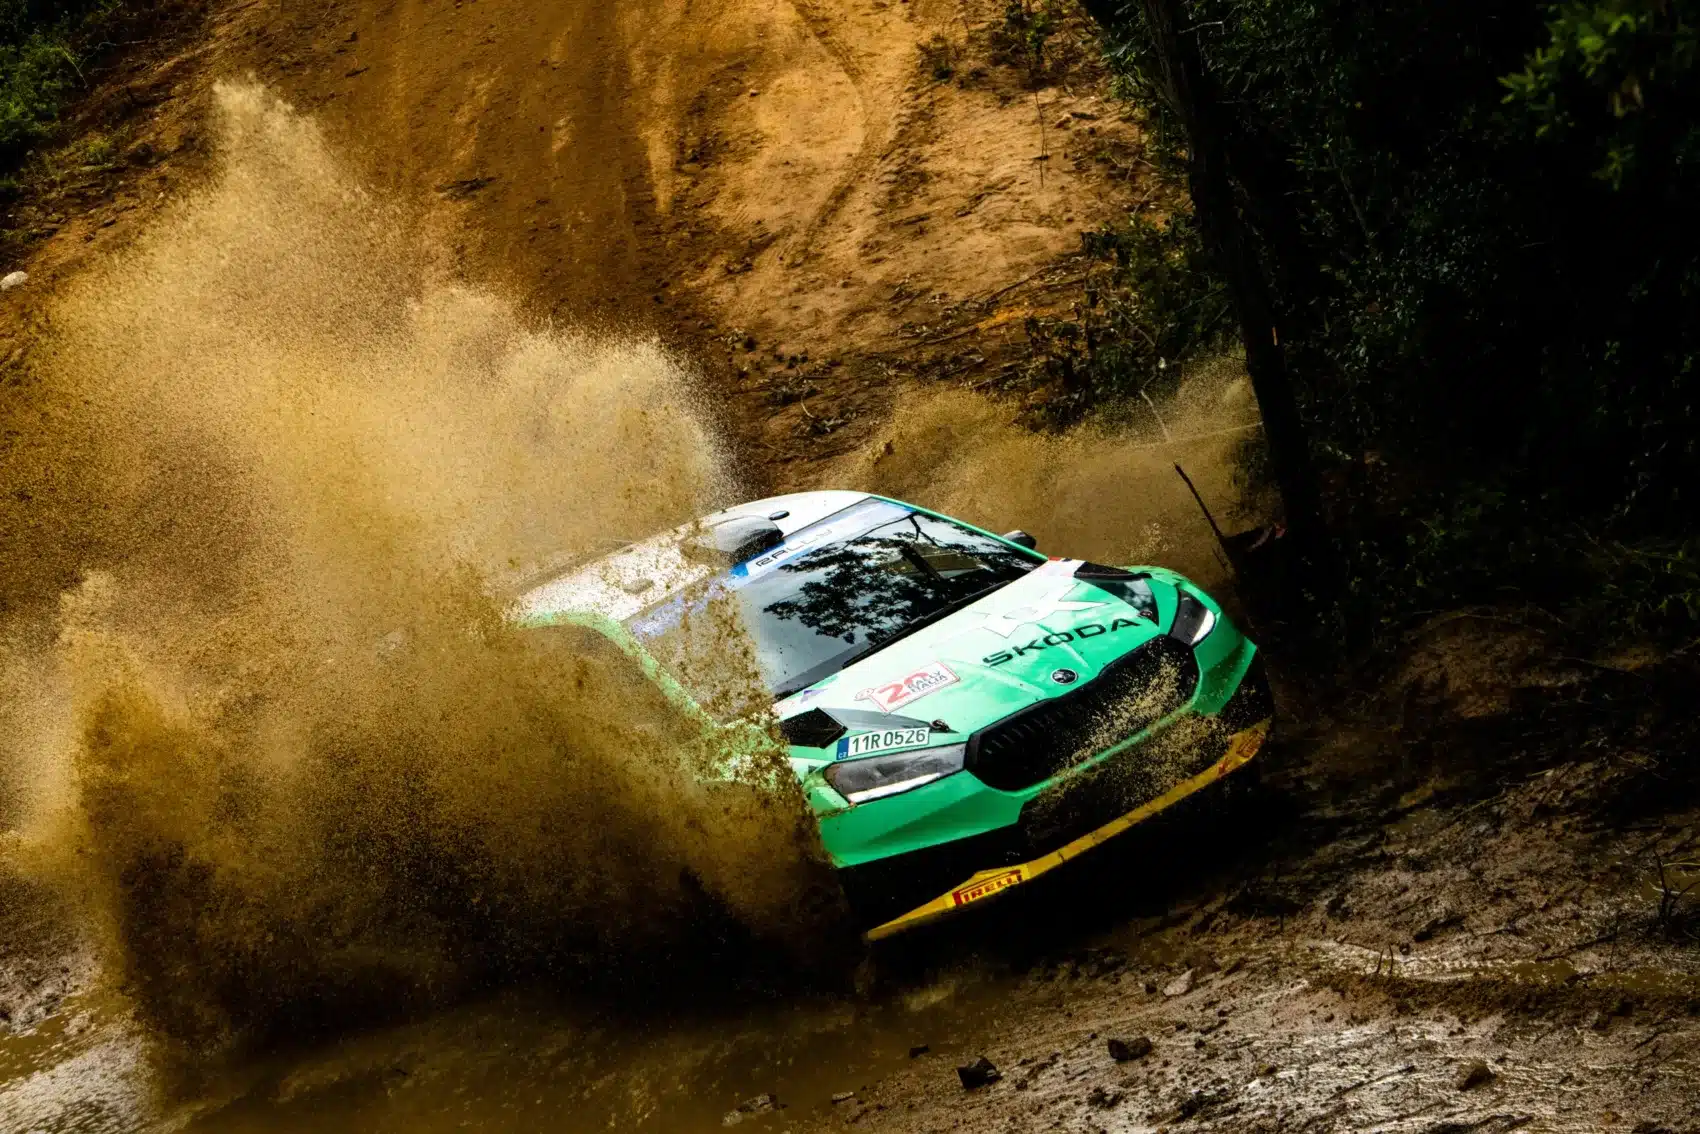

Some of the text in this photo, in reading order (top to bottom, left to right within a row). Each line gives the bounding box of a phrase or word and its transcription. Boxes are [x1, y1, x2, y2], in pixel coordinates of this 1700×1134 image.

[852, 729, 926, 753] 11R 0526
[838, 750, 847, 759] CZ
[952, 869, 1022, 905] PIRELLI
